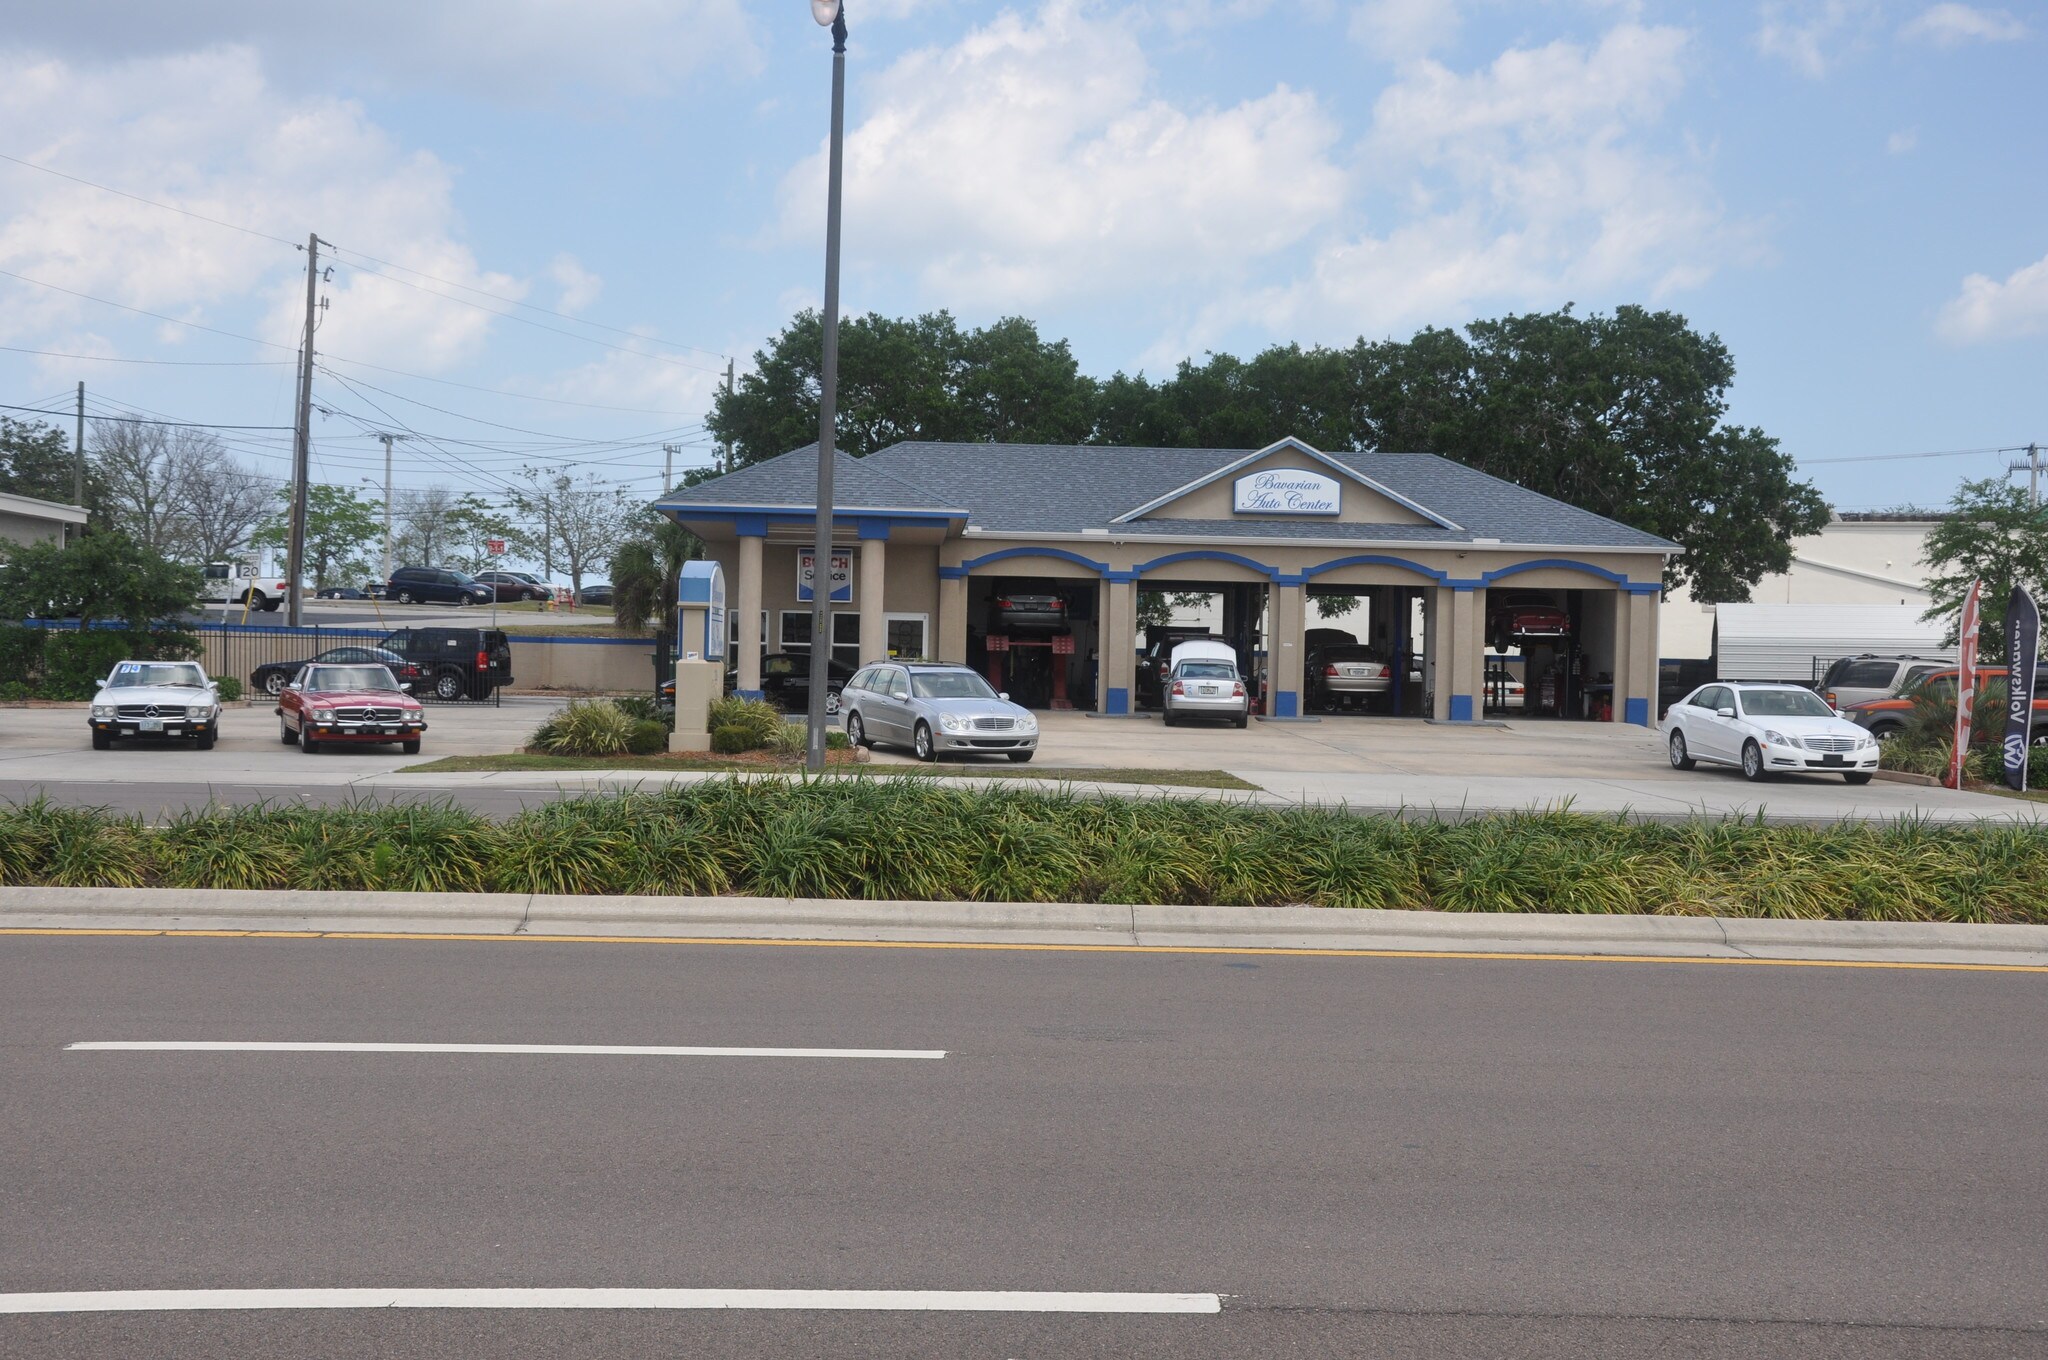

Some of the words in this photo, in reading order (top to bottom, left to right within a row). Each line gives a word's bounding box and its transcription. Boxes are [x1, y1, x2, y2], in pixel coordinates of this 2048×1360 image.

[1254, 473, 1321, 490] Bavarian
[1242, 490, 1281, 509] Auto
[1284, 490, 1333, 510] Center
[802, 556, 848, 569] BCH
[243, 566, 258, 577] 20
[804, 570, 847, 581] Sice
